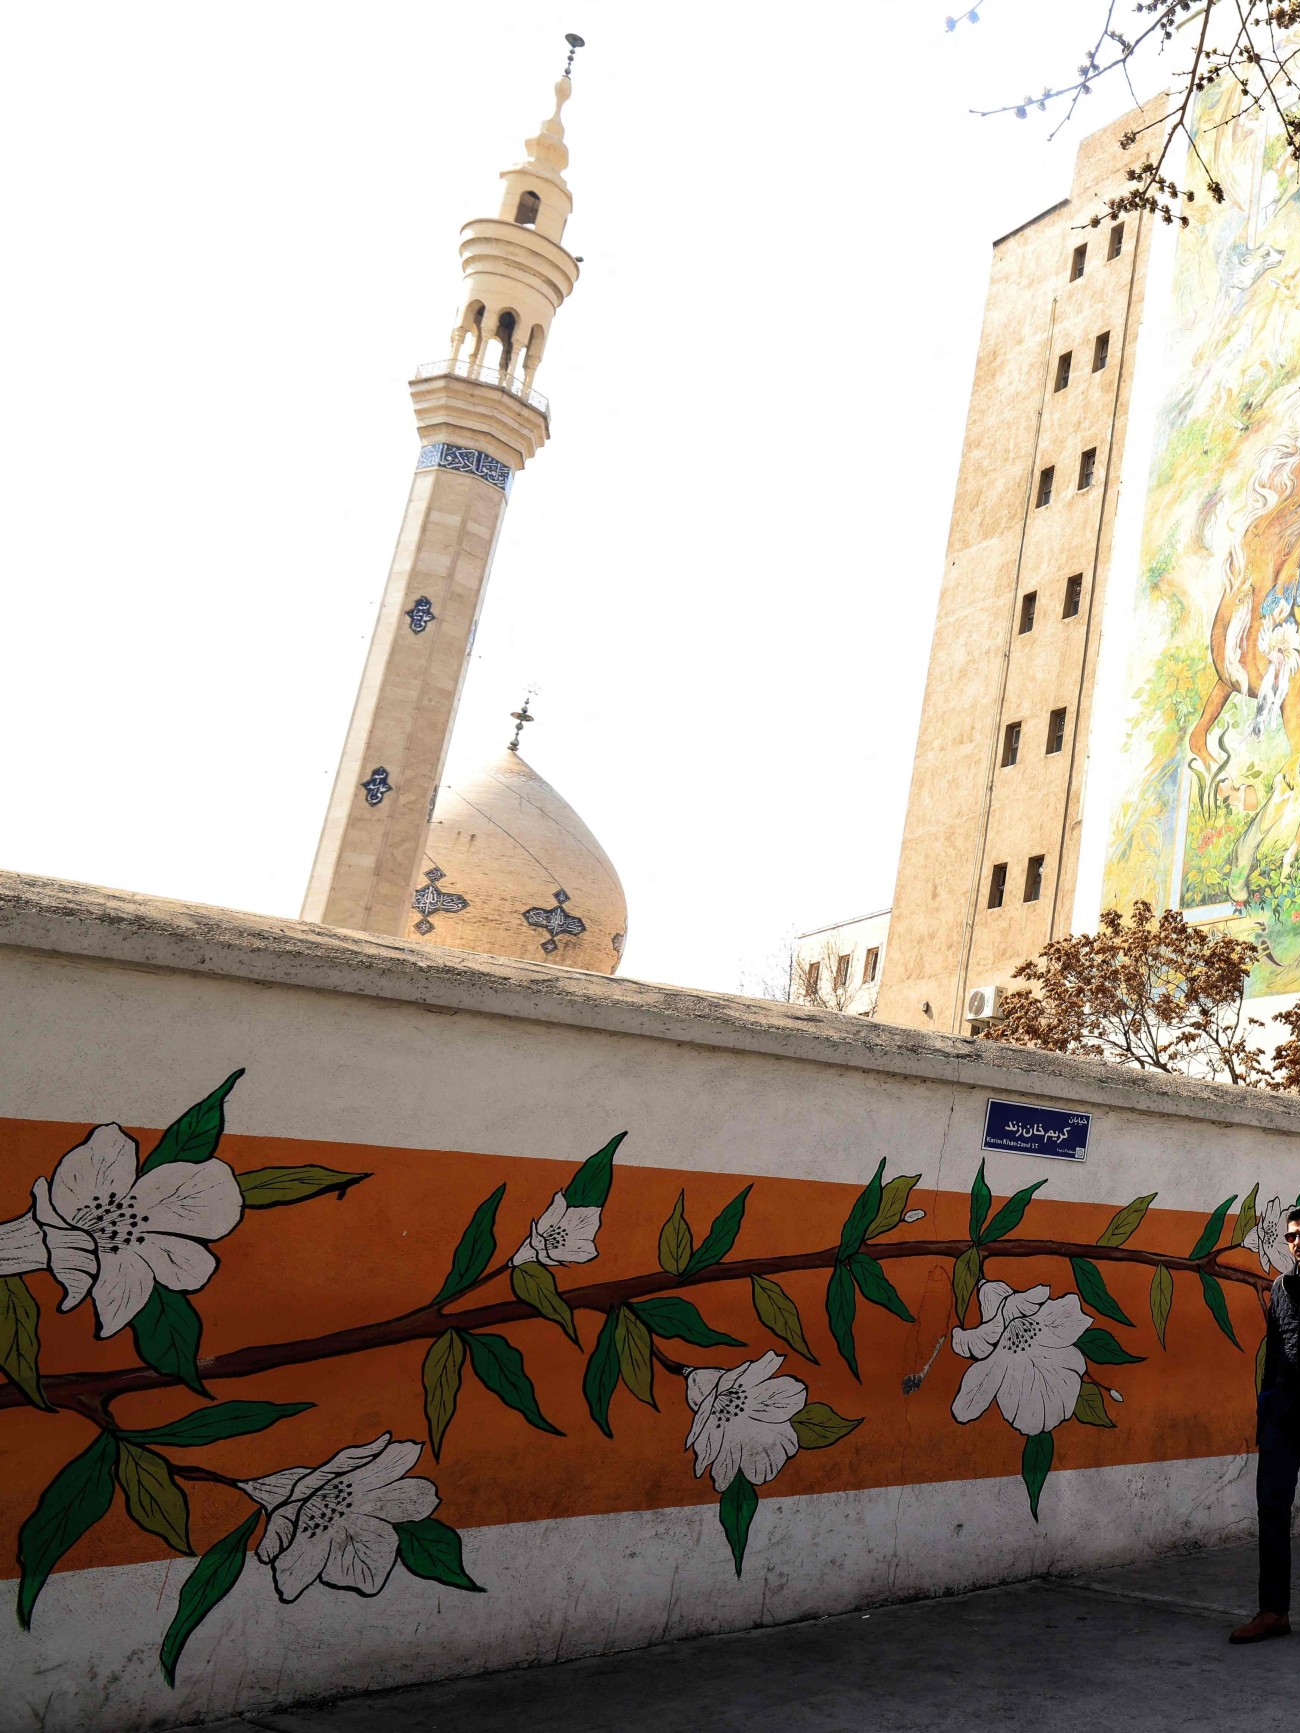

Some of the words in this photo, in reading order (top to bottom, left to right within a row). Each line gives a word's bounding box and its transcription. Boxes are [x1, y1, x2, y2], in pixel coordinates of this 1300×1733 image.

[1068, 1116, 1088, 1125] خیابان
[1004, 1120, 1022, 1137] زند
[1022, 1124, 1045, 1137] خان
[1044, 1127, 1071, 1143] کریم
[986, 1136, 1002, 1145] Karim
[1002, 1139, 1017, 1147] Khan
